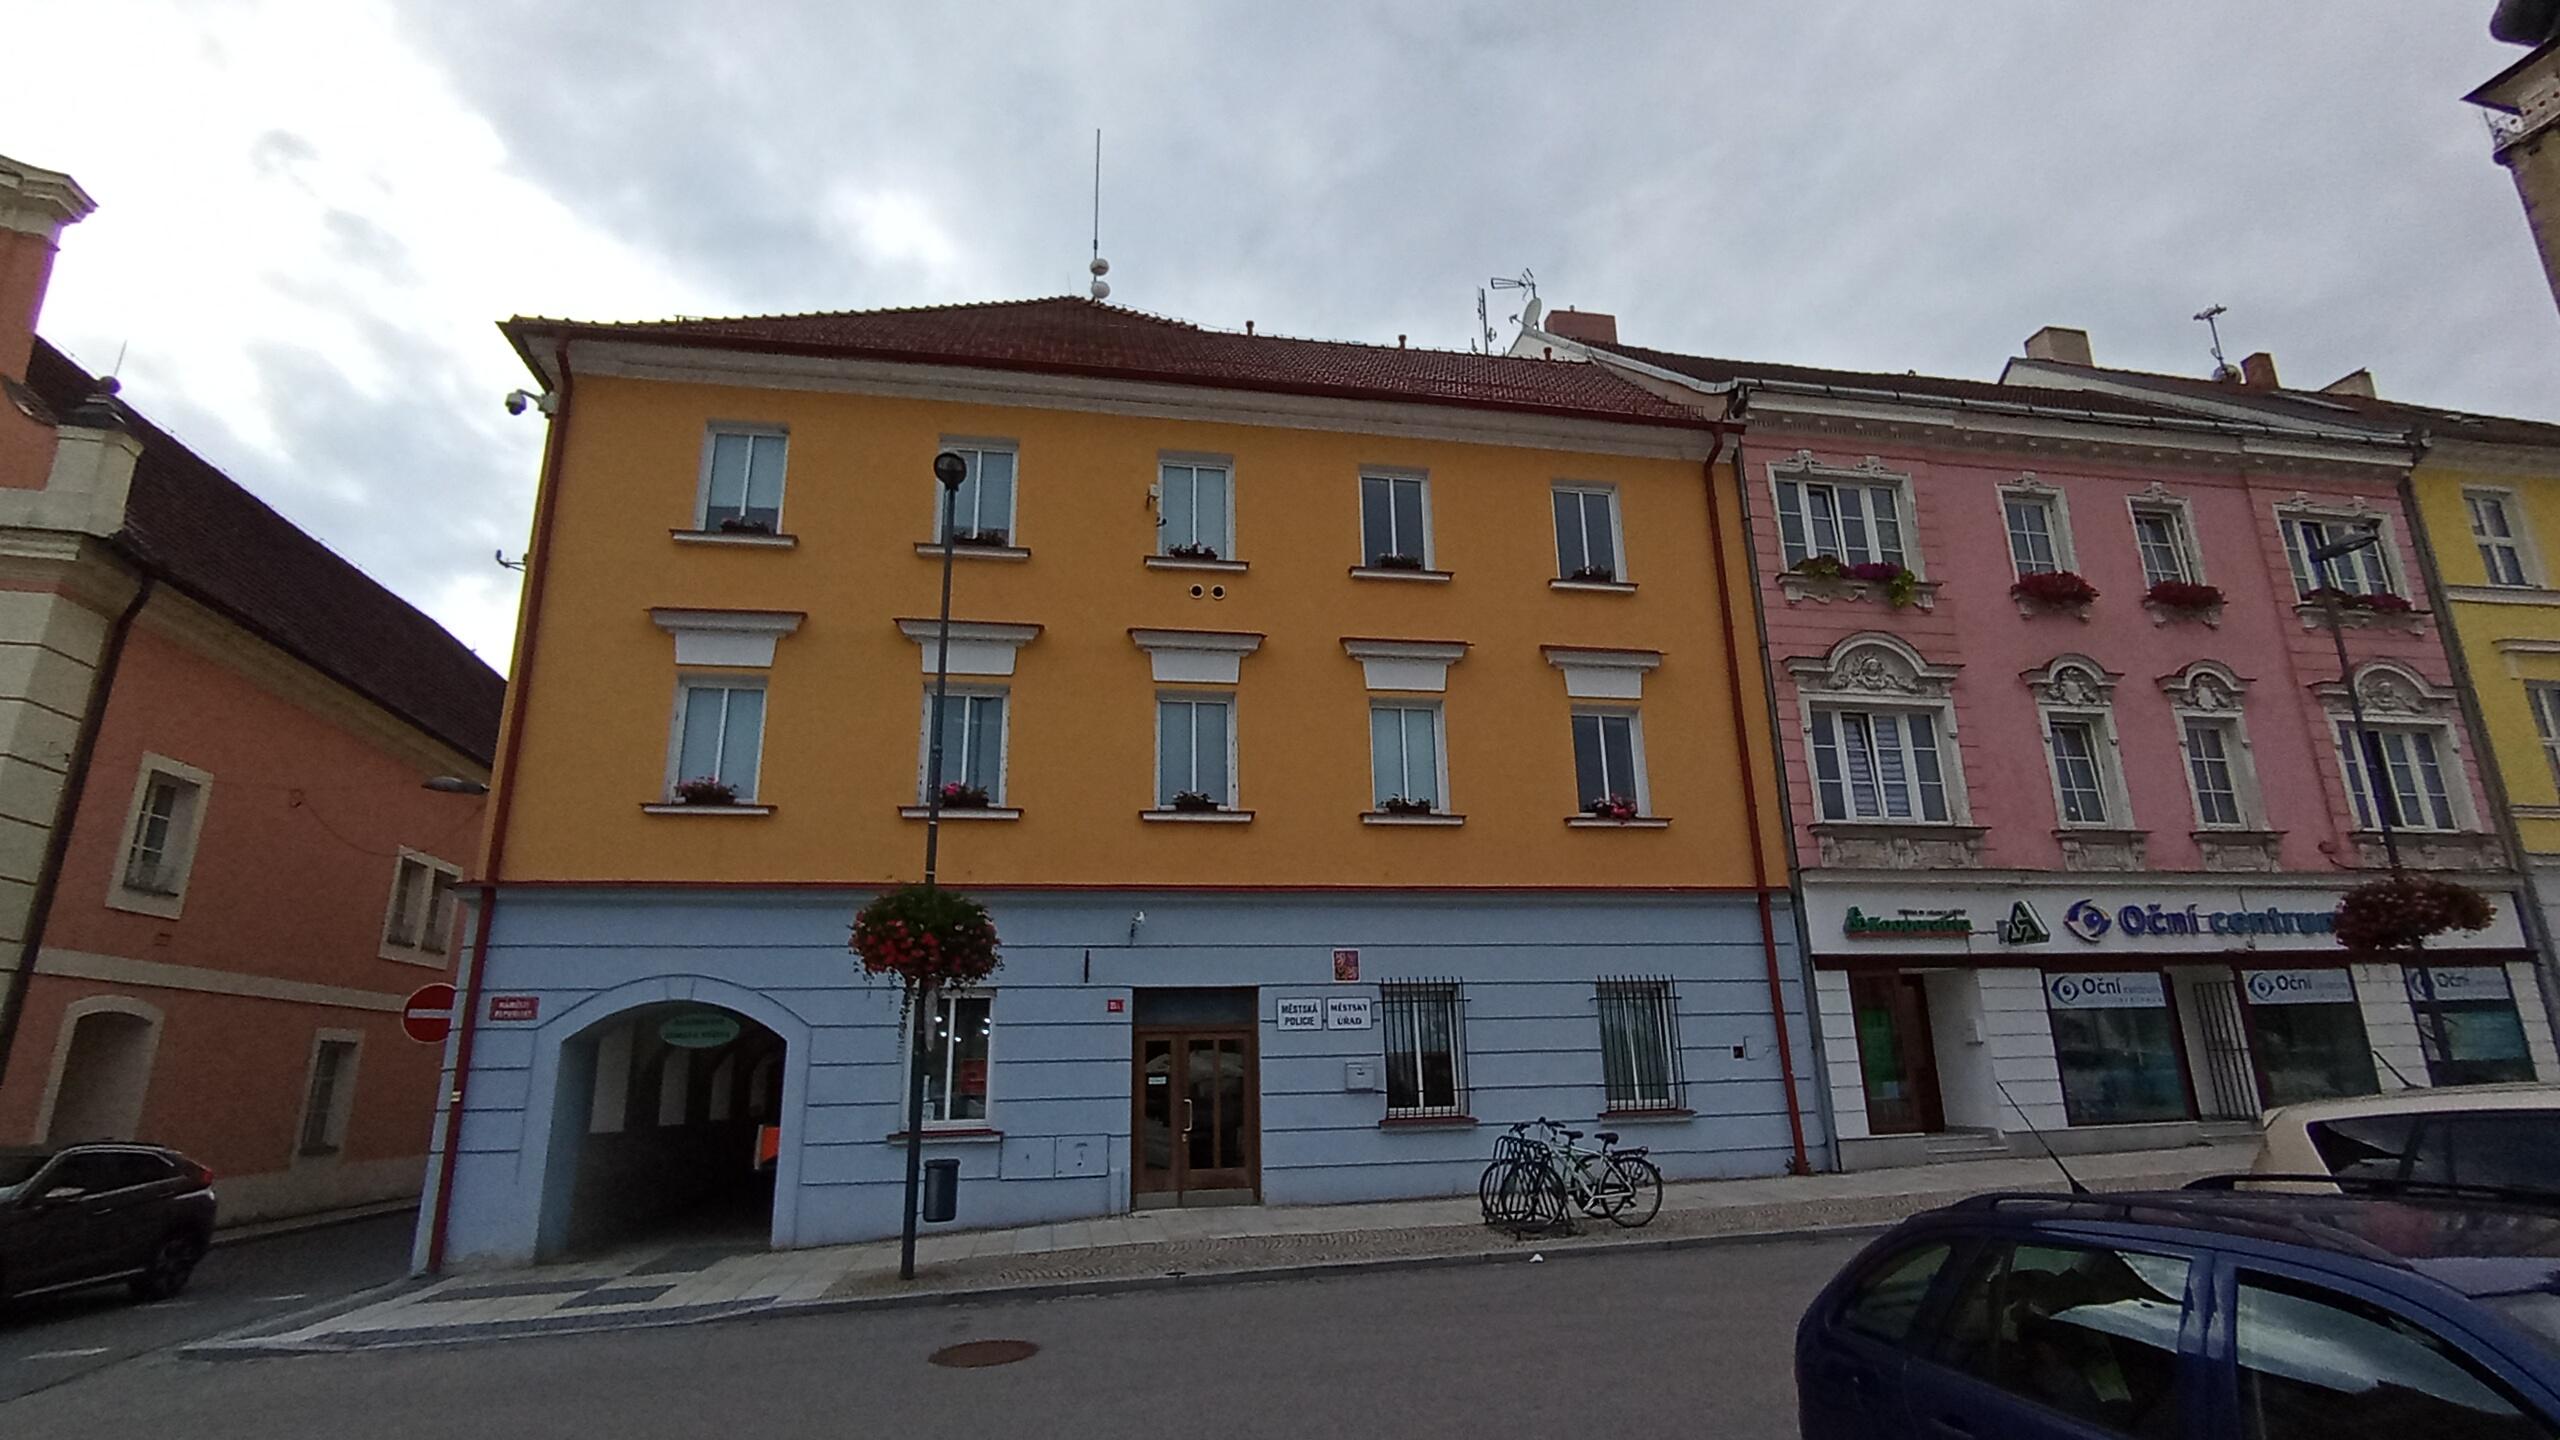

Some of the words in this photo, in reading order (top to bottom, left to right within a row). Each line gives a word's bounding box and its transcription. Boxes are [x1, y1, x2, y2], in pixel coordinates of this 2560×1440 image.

[2118, 903, 2200, 935] Oční
[2082, 976, 2121, 994] Oční
[1284, 1016, 1315, 1026] POLICIE
